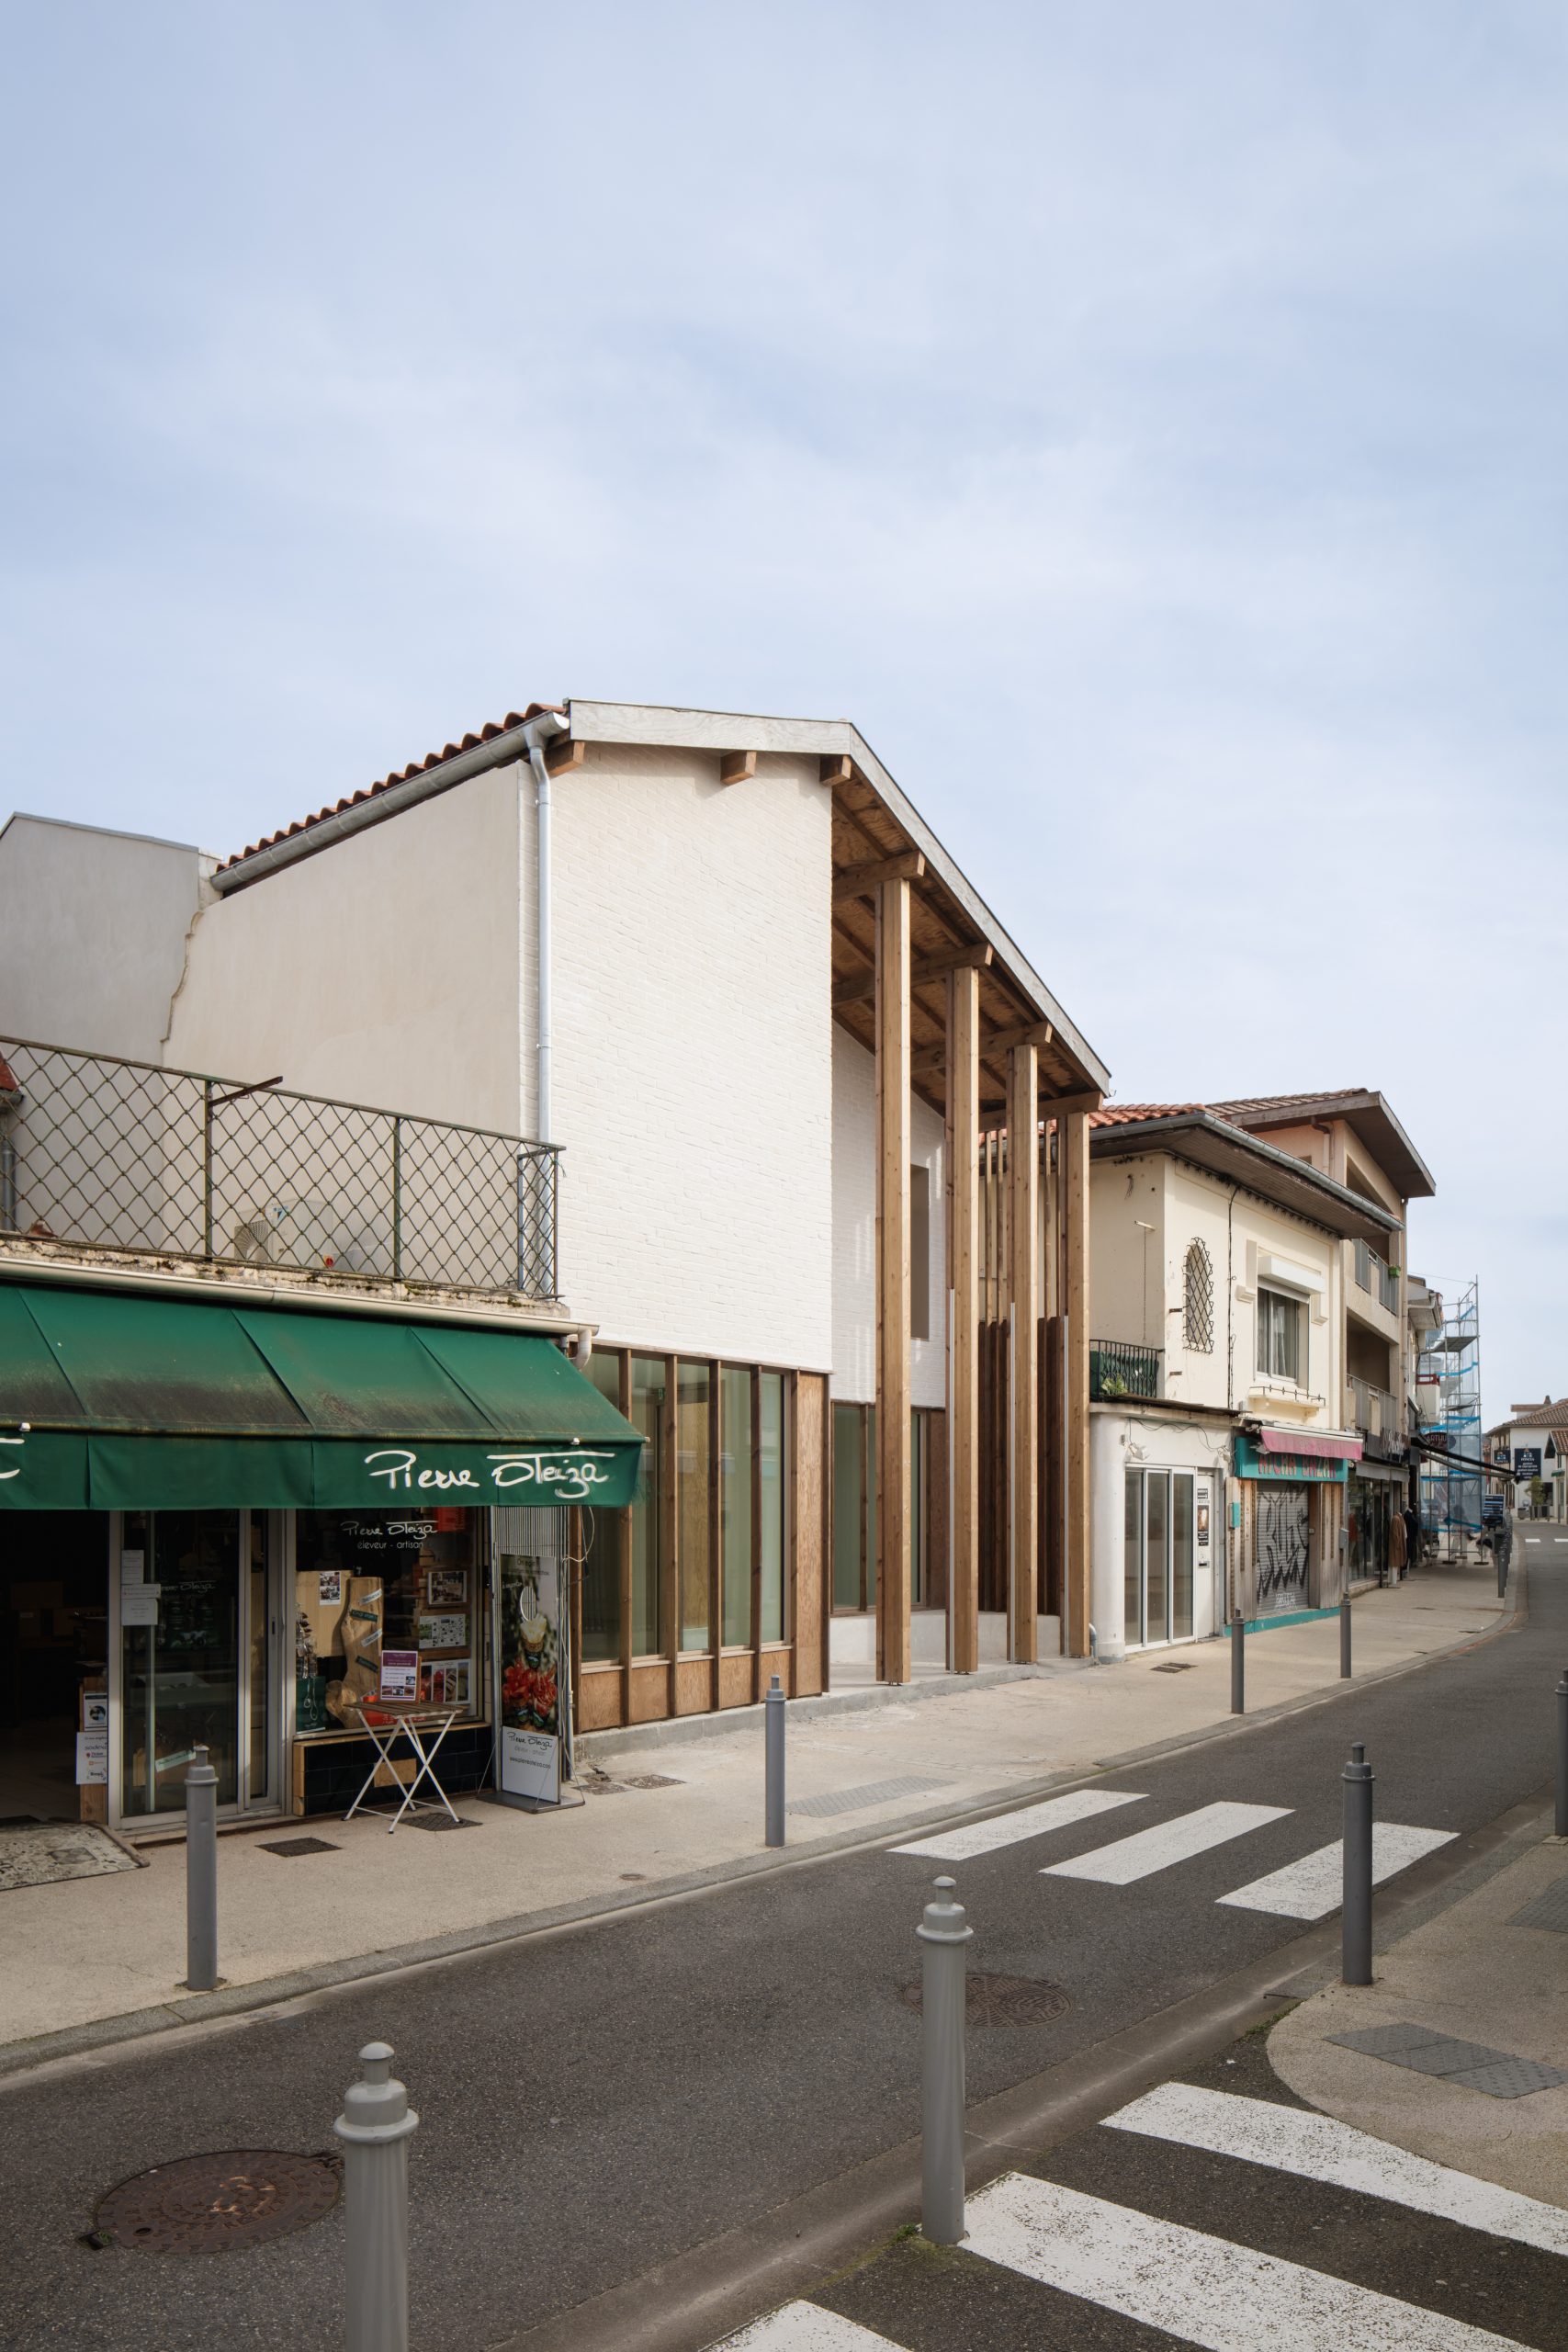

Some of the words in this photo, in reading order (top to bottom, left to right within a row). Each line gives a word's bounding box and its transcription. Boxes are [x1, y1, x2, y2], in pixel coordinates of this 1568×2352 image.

[365, 1450, 479, 1488] Pierre
[340, 1521, 383, 1535] Pierre
[396, 1541, 423, 1549] artisan
